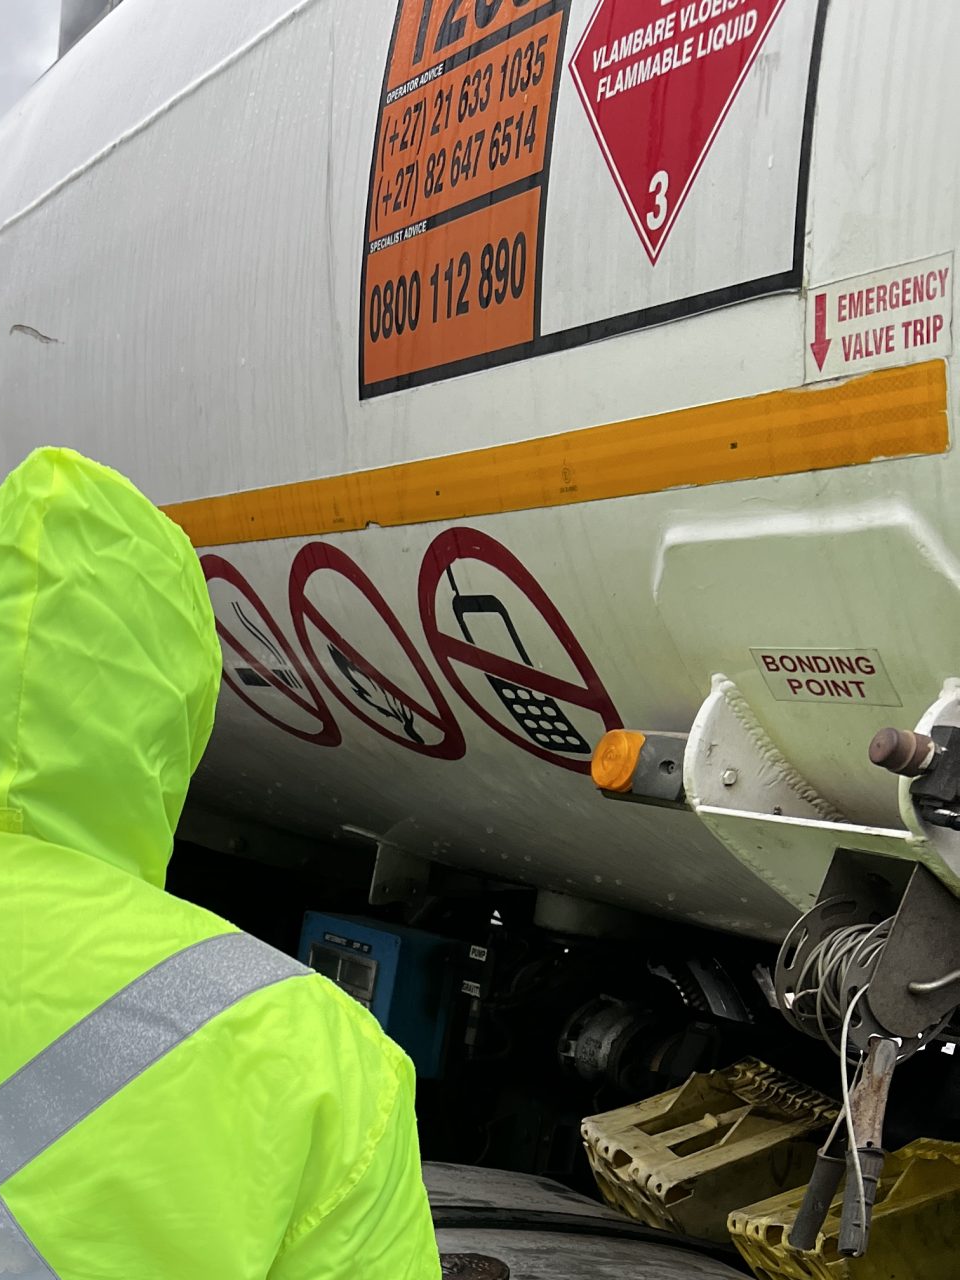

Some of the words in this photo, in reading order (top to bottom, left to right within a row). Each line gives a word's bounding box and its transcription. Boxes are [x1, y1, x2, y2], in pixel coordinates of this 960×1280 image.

[592, 11, 676, 72] VLAMBARE
[596, 37, 694, 103] FLAMMABLE
[696, 9, 758, 59] LIQUID
[381, 97, 427, 172] (+27)
[431, 84, 453, 136] 21
[457, 63, 493, 123] 633
[499, 34, 548, 102] 1035
[386, 77, 419, 104] OPERATOR
[419, 63, 444, 86] ADVICE
[375, 159, 419, 232] (+27)
[424, 148, 446, 199] 82
[450, 129, 485, 188] 647
[489, 105, 538, 171] 6514
[646, 170, 669, 231] 3
[370, 230, 404, 254] SPECIALIST
[404, 220, 428, 240] ADVICE
[370, 270, 421, 343] 0800
[430, 251, 471, 323] 112
[478, 231, 527, 309] 890
[837, 267, 949, 322] EMERGENCY
[841, 324, 895, 362] VALVE
[901, 314, 944, 349] TRIP
[761, 655, 876, 675] BONDING
[787, 678, 866, 698] POINT
